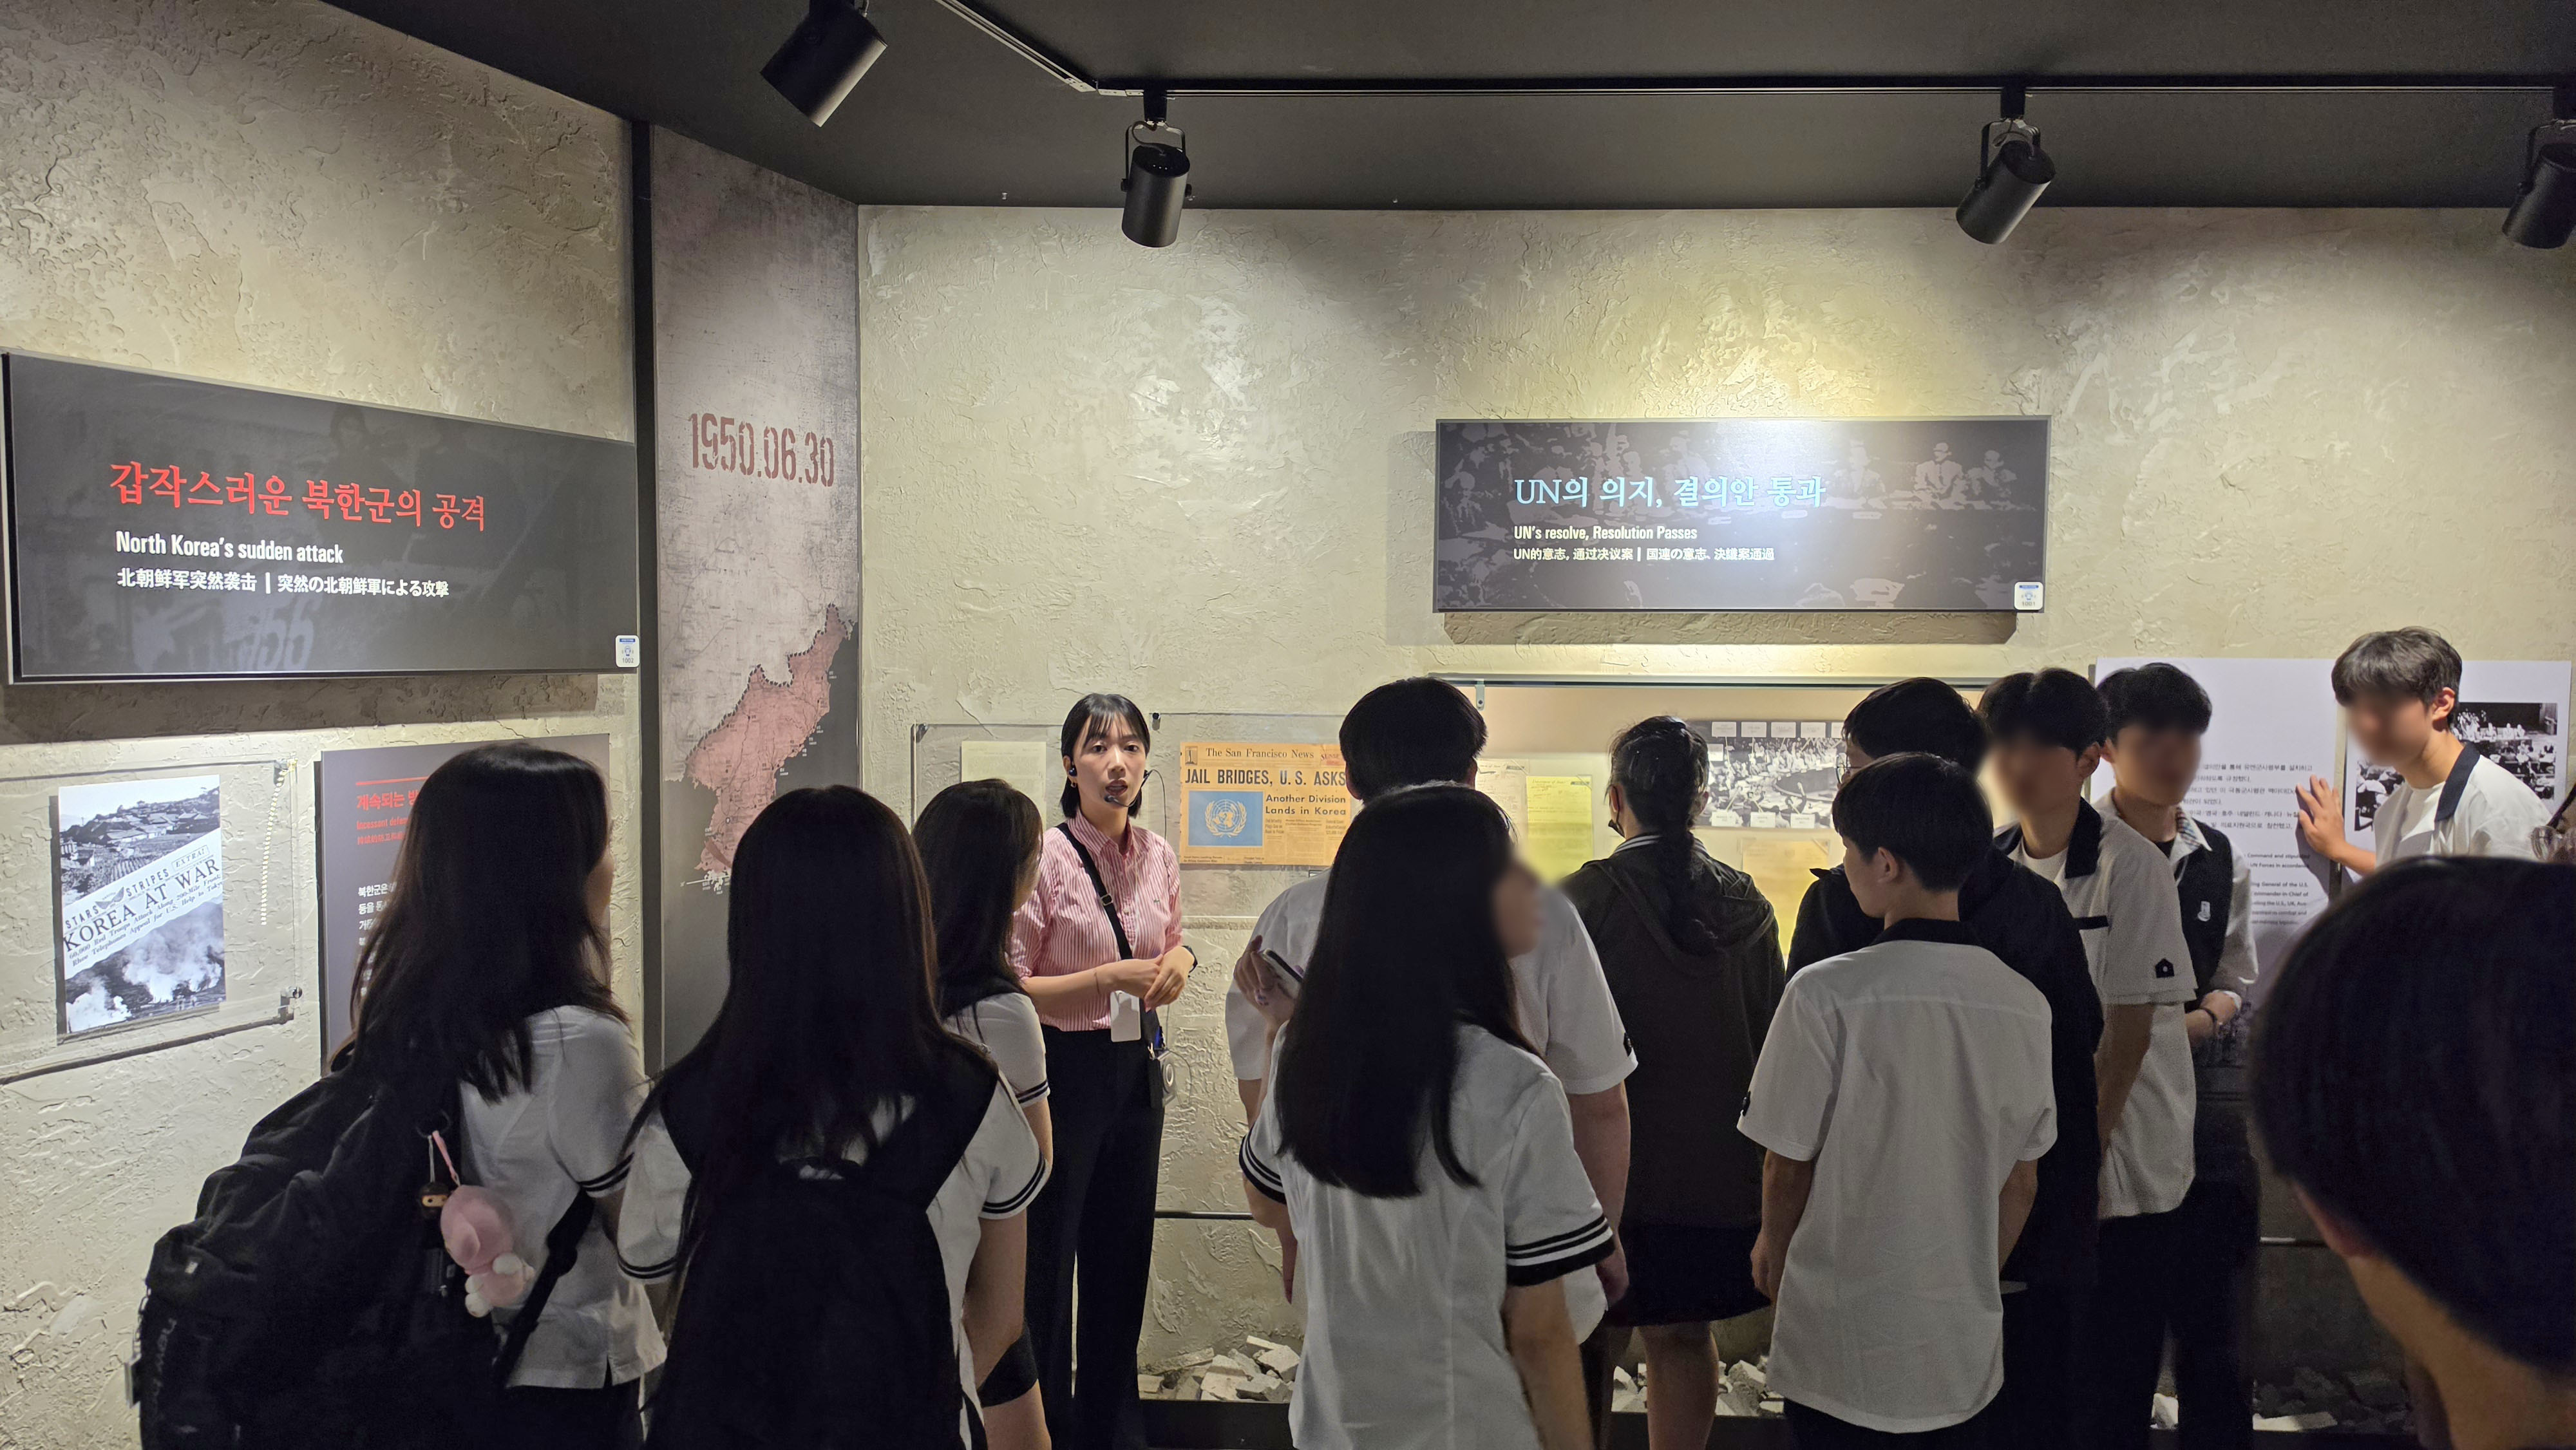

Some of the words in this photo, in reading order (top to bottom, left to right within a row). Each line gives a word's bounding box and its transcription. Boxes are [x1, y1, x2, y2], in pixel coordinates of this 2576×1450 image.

[688, 413, 835, 487] 1950.06.30
[110, 460, 293, 515] 갑작스러운
[302, 479, 421, 527] 북한군의
[432, 493, 484, 532] 공격
[1514, 476, 1588, 508] UN의
[1599, 476, 1663, 509] 의지,
[1674, 476, 1759, 507] 결의안
[1766, 475, 1827, 508] 통과
[1513, 525, 1542, 540] UN's
[1544, 525, 1590, 542] resolve,
[1593, 525, 1654, 540] Resolution
[1656, 525, 1698, 540] Passes
[115, 530, 167, 554] North
[171, 534, 234, 558] Korea's
[238, 540, 293, 561] sudden
[296, 544, 344, 564] attack
[117, 567, 258, 592] 北朝鲜军突然袭击
[278, 573, 450, 598] 突然の北朝鮮軍による攻撃
[1206, 748, 1222, 757] The
[1226, 748, 1242, 758] San
[1246, 749, 1287, 758] Francisco
[1291, 749, 1314, 758] News
[1185, 769, 1210, 784] JAIL
[1217, 769, 1273, 787] BRIDGES,
[1314, 771, 1347, 786] ASKS
[356, 791, 404, 811] 계속되는
[1265, 794, 1305, 803] Another
[1309, 794, 1346, 804] Division
[1265, 806, 1296, 814] Lands
[1301, 807, 1309, 815] in
[1314, 807, 1346, 816] Korea
[63, 904, 136, 952] KOREA
[145, 883, 168, 909] AT
[175, 859, 220, 889] WAR
[65, 905, 100, 928] STARS
[126, 868, 169, 896] STRIPES
[130, 919, 150, 935] Appeal
